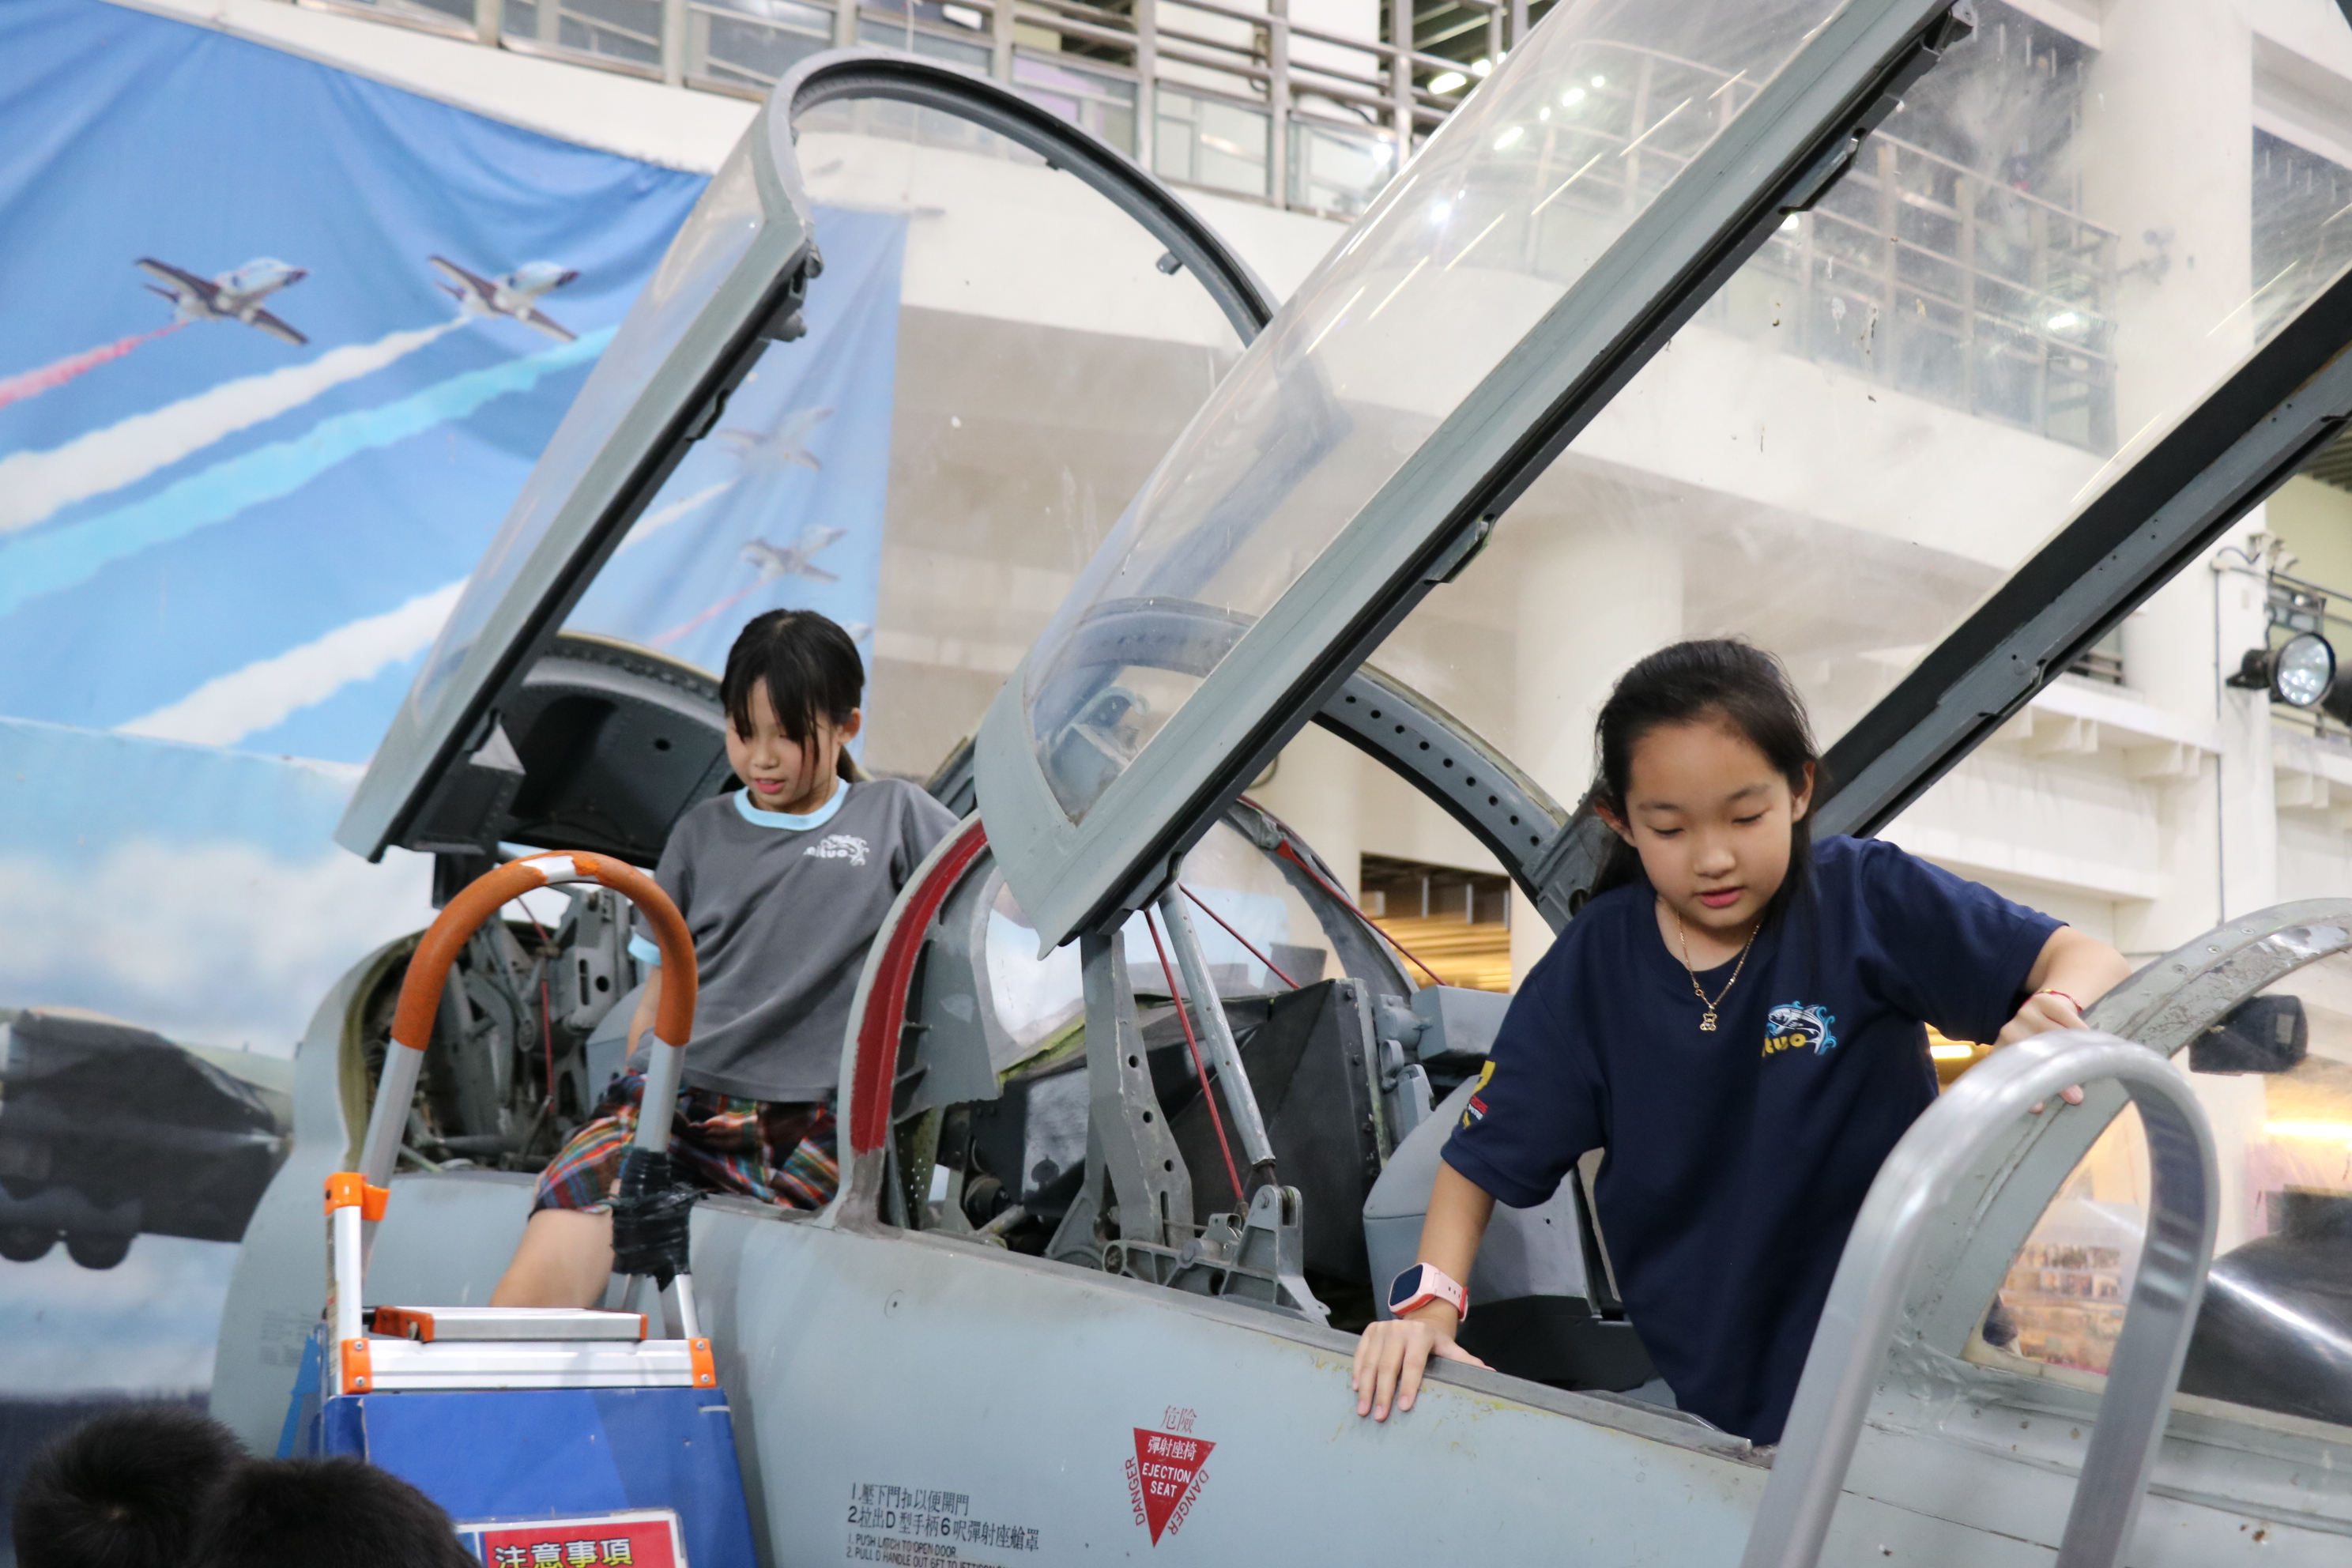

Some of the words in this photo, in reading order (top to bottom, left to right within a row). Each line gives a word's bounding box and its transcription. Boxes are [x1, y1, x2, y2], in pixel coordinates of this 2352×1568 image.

[1160, 1404, 1197, 1434] 危險
[1147, 1435, 1198, 1461] 彈射座椅
[1142, 1462, 1192, 1484] EJECTION
[1125, 1456, 1146, 1526] DANGER
[1150, 1480, 1178, 1498] SEAT
[1167, 1468, 1209, 1536] DANGER
[494, 1537, 634, 1568] 注意事項
[856, 1533, 876, 1547] PUSH
[902, 1540, 911, 1552] TO
[913, 1541, 934, 1555] OPEN
[855, 1547, 873, 1561] PULL
[876, 1550, 881, 1562] D
[882, 1551, 910, 1566] HANDLE
[913, 1555, 928, 1568] OUT
